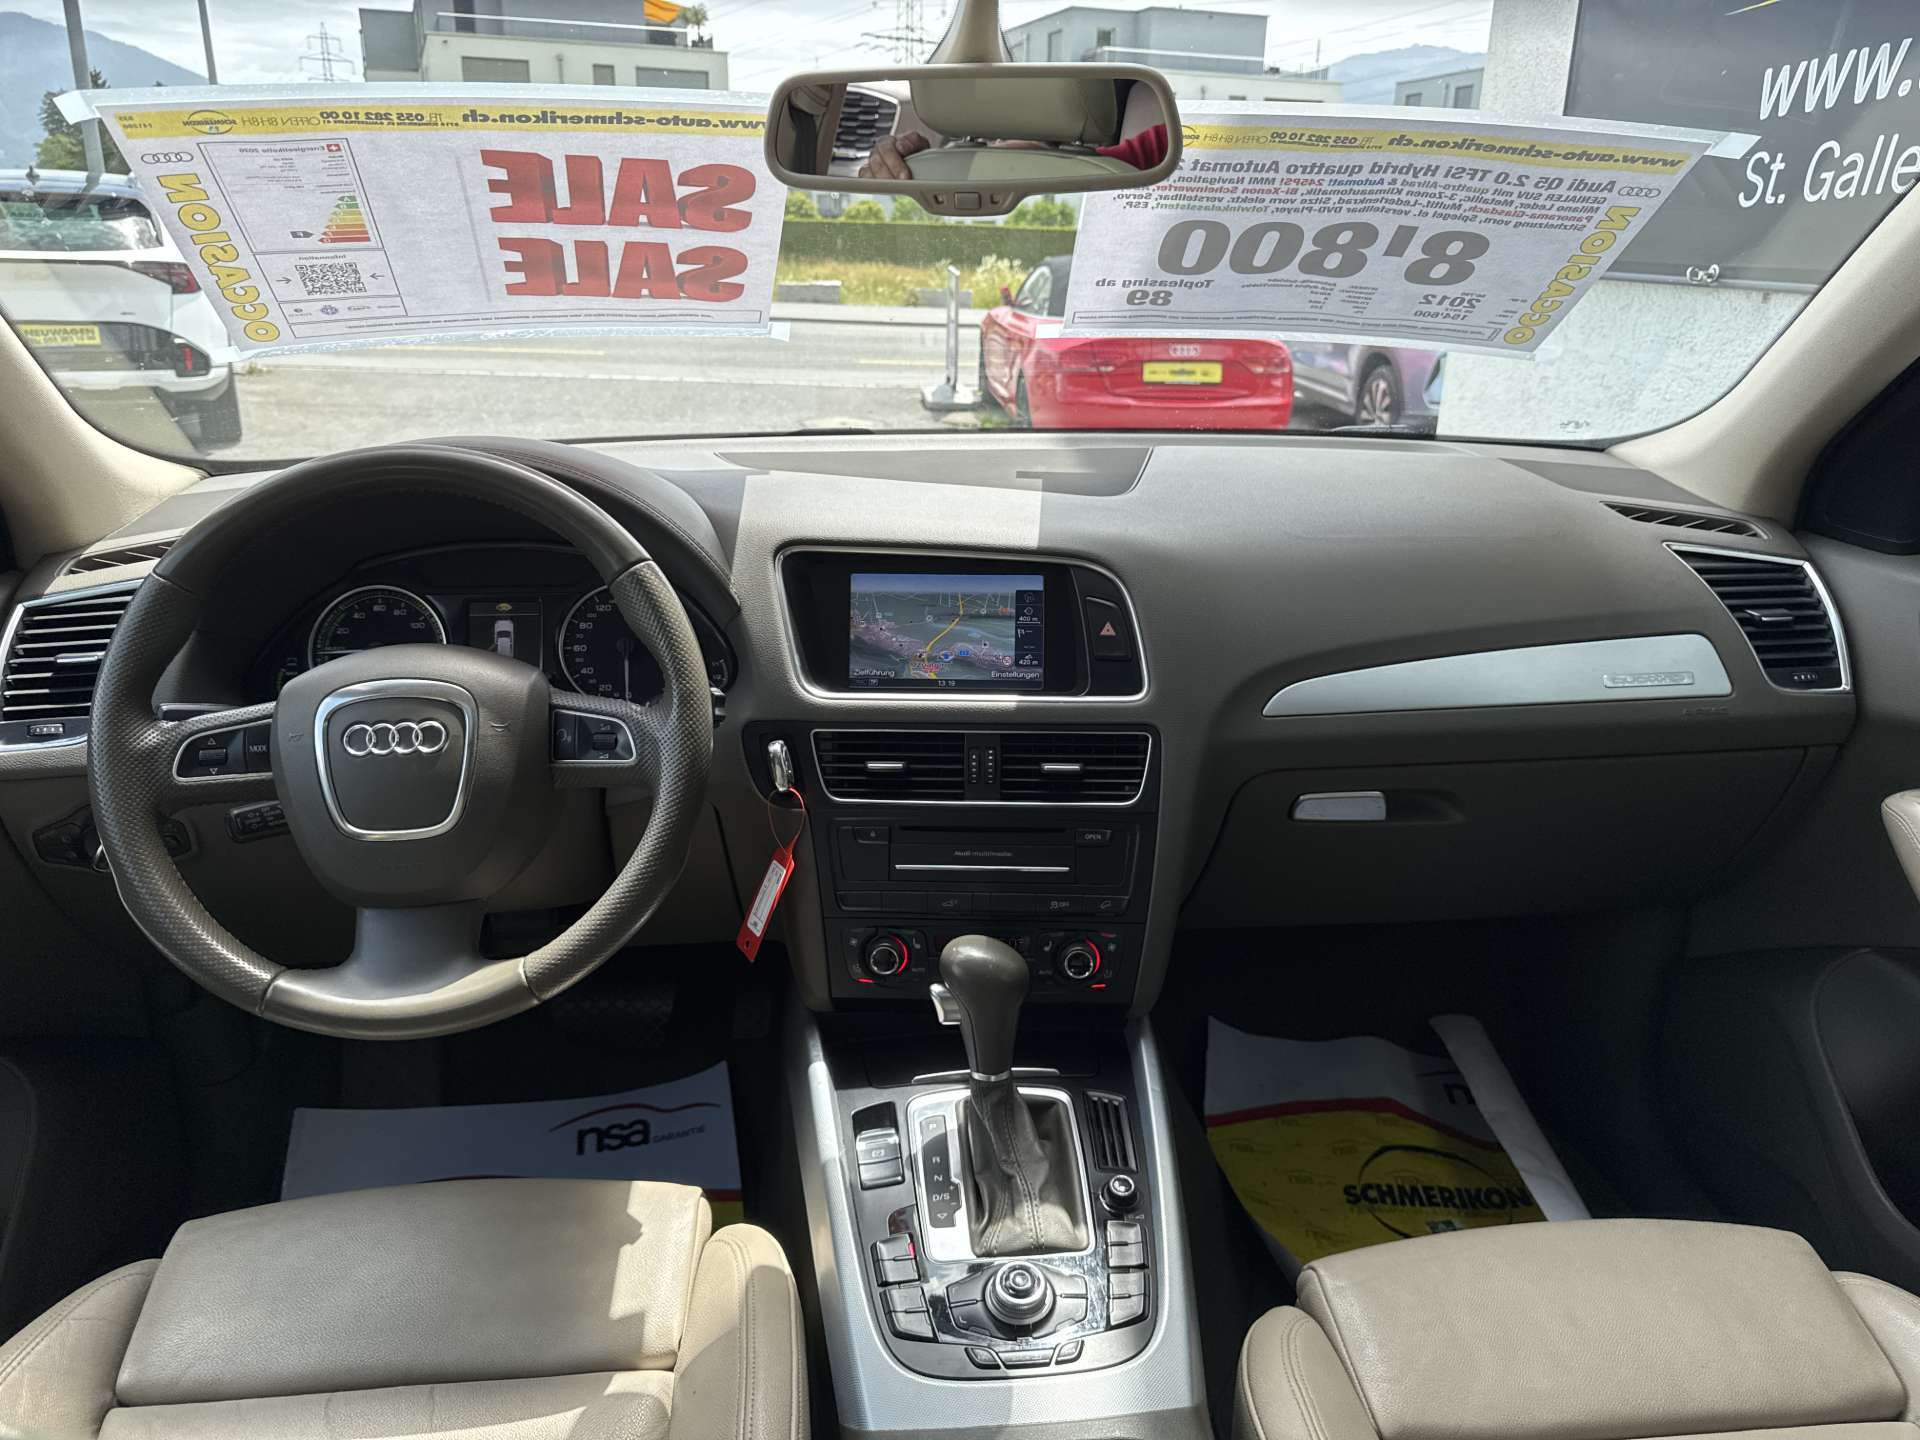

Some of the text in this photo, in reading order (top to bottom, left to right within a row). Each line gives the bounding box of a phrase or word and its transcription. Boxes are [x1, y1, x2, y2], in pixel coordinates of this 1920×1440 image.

[1759, 37, 1920, 120] www.
[1738, 151, 1786, 208] St.
[336, 627, 349, 635] 20
[853, 668, 895, 677] Zielführung
[991, 671, 1040, 679] Einstellungen
[953, 849, 971, 857] Audi
[576, 1119, 650, 1155] nsa
[933, 1192, 950, 1201] D/S
[1342, 1183, 1535, 1211] SCHMERIKON
